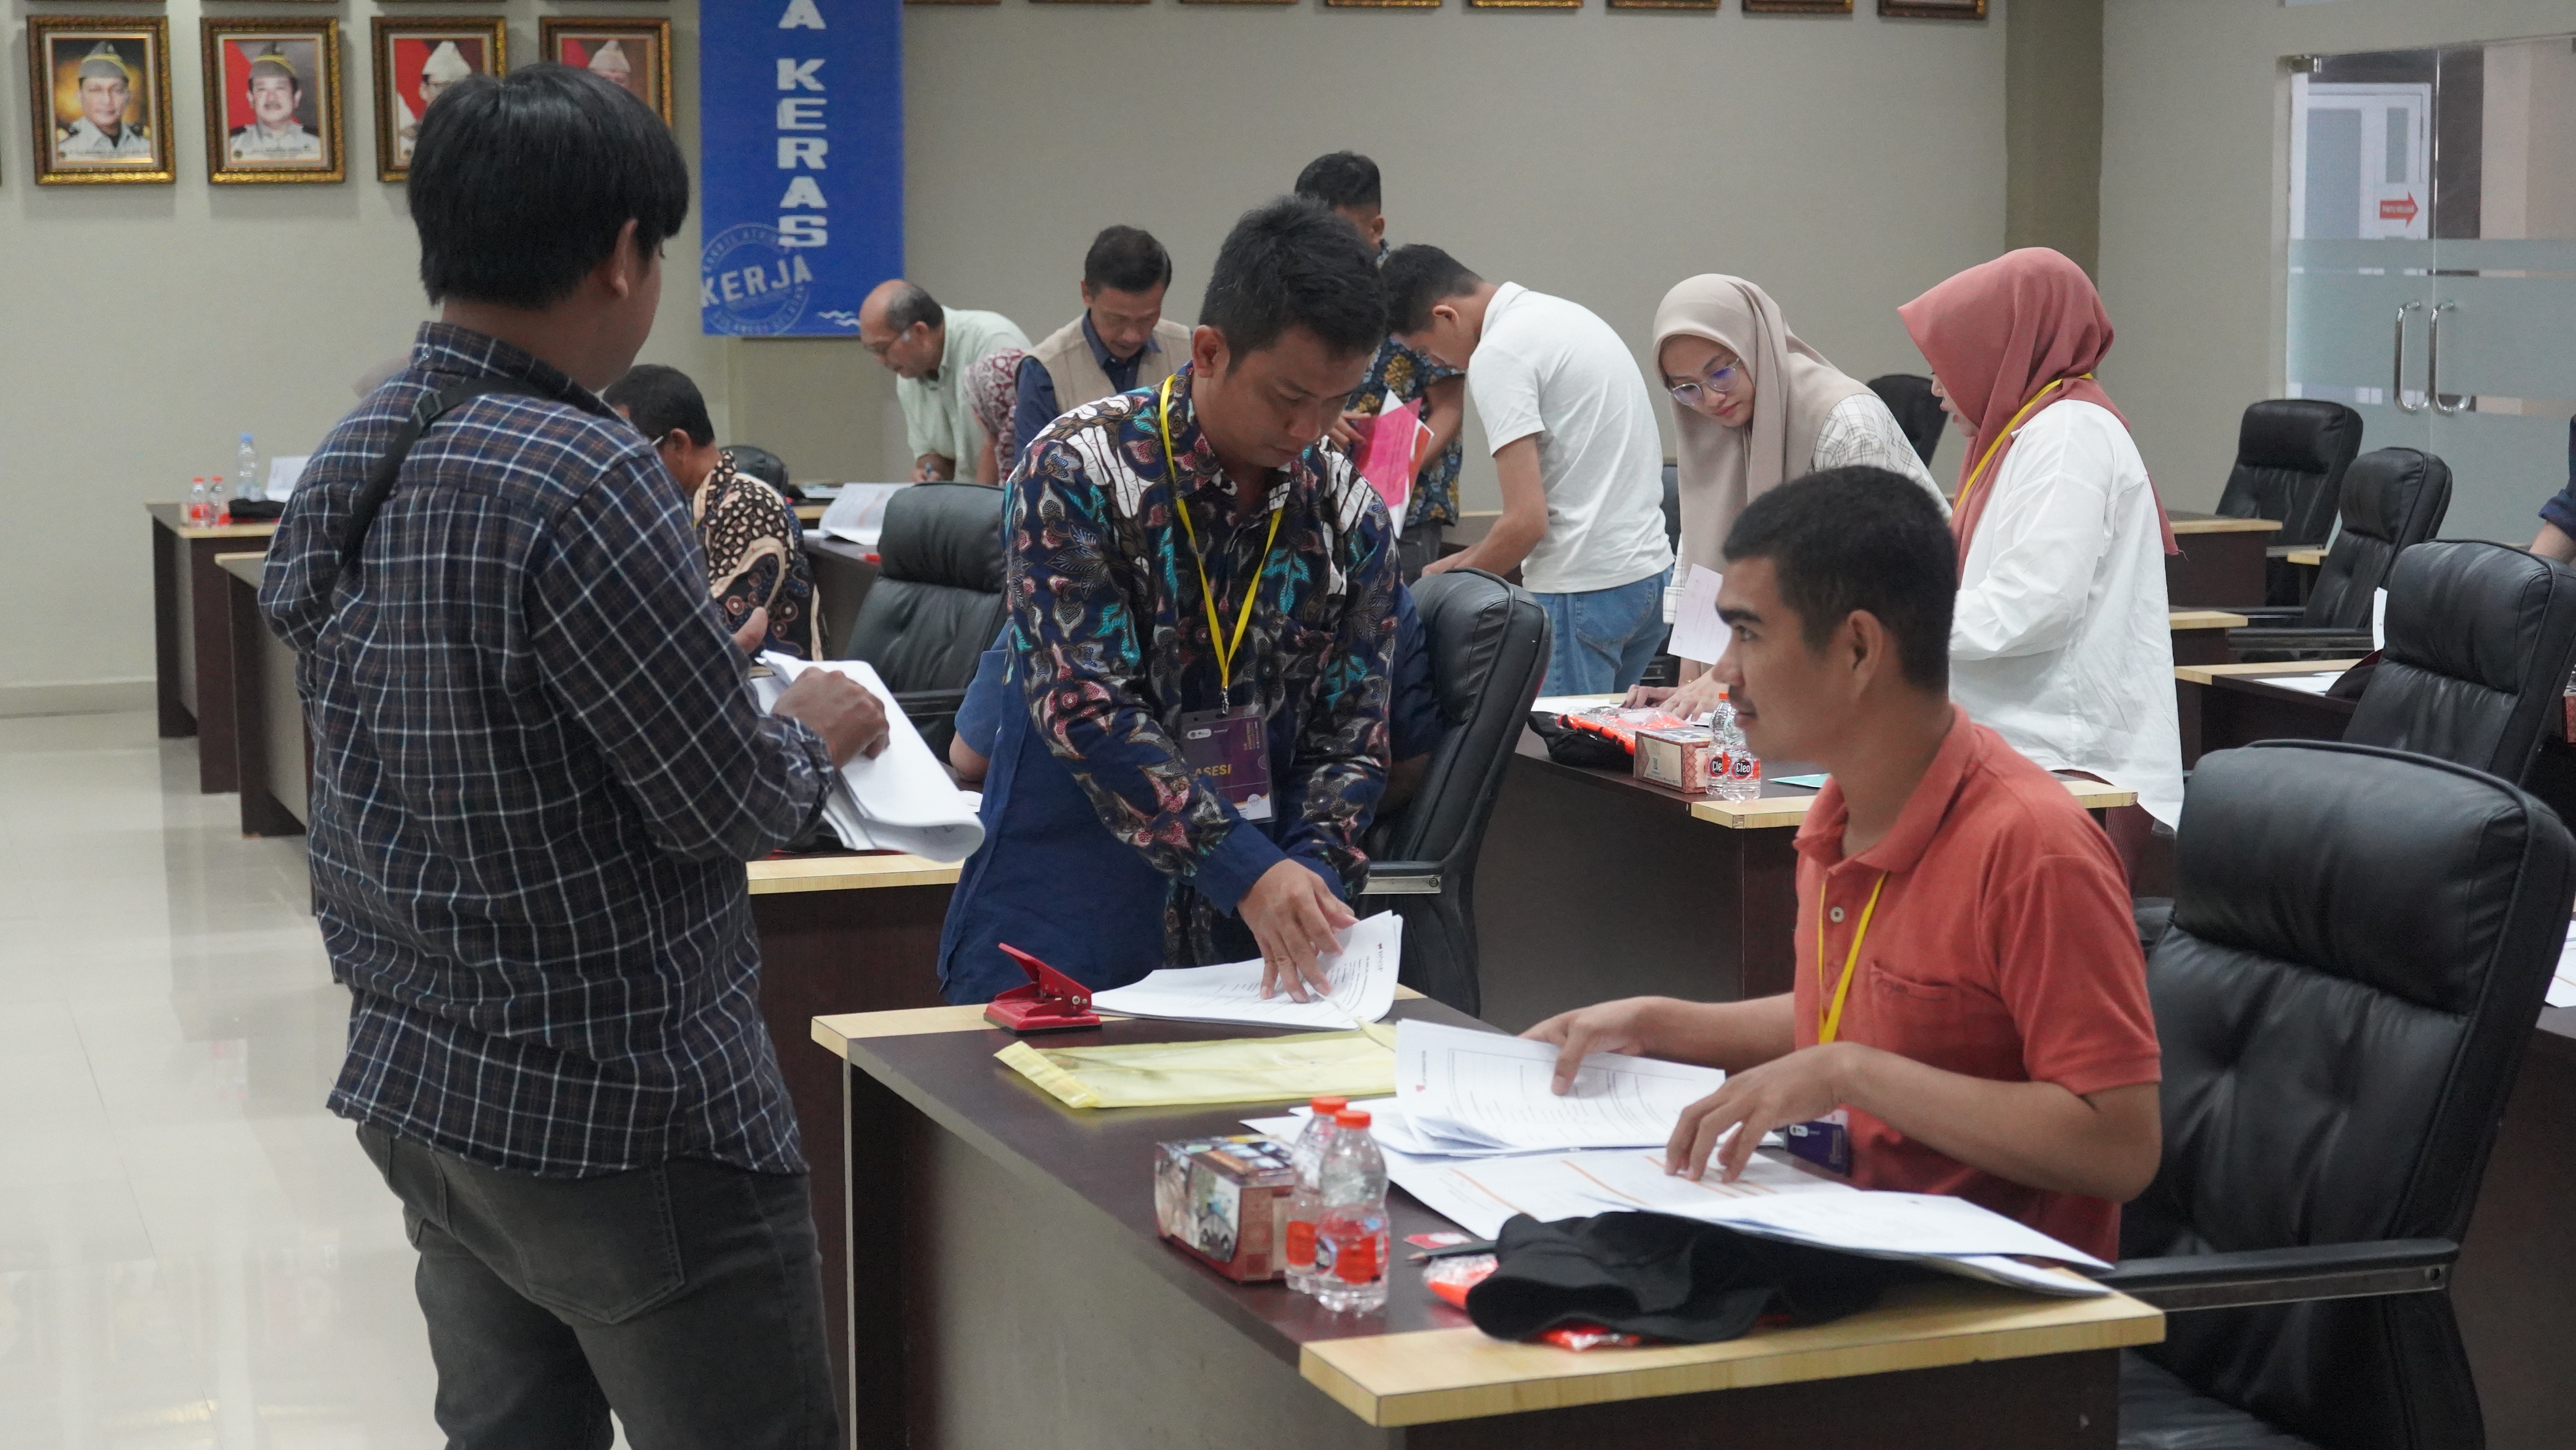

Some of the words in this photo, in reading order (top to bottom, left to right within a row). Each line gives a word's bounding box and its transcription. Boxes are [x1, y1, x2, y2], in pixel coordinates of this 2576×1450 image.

[777, 58, 828, 247] KERAS
[700, 255, 814, 308] KERJA
[1712, 761, 1723, 771] Cle
[1736, 762, 1751, 773] Cleo
